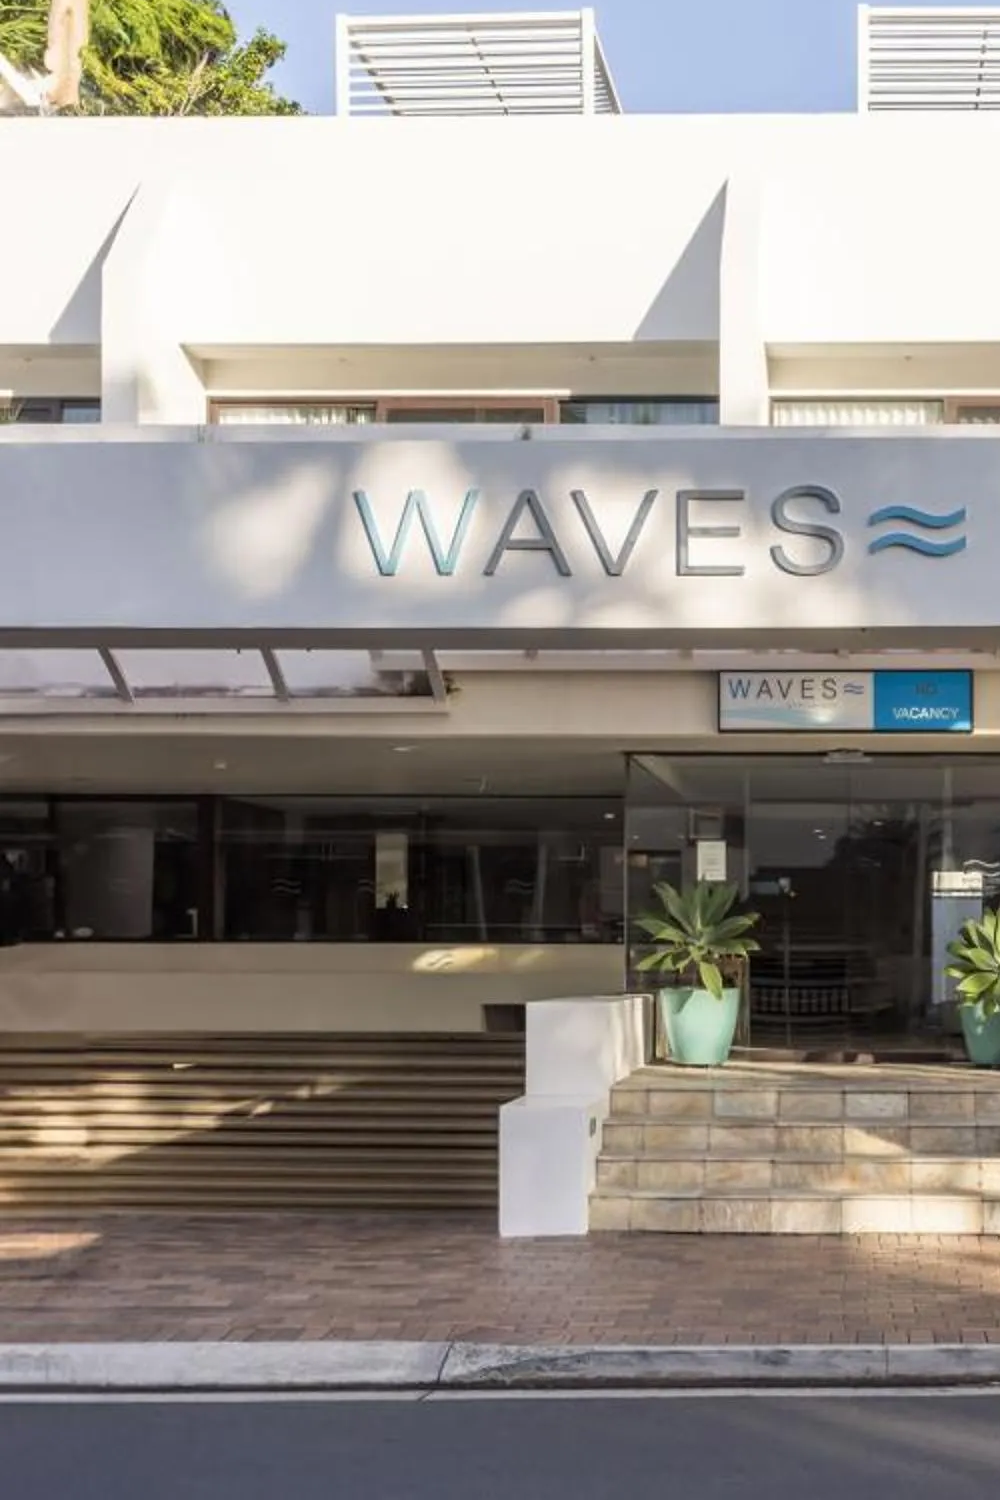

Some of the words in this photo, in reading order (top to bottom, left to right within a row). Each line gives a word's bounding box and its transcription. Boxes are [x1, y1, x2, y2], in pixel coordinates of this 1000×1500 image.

[353, 485, 845, 576] WAVES
[728, 678, 837, 700] WAVES
[892, 707, 960, 720] VACANCY
